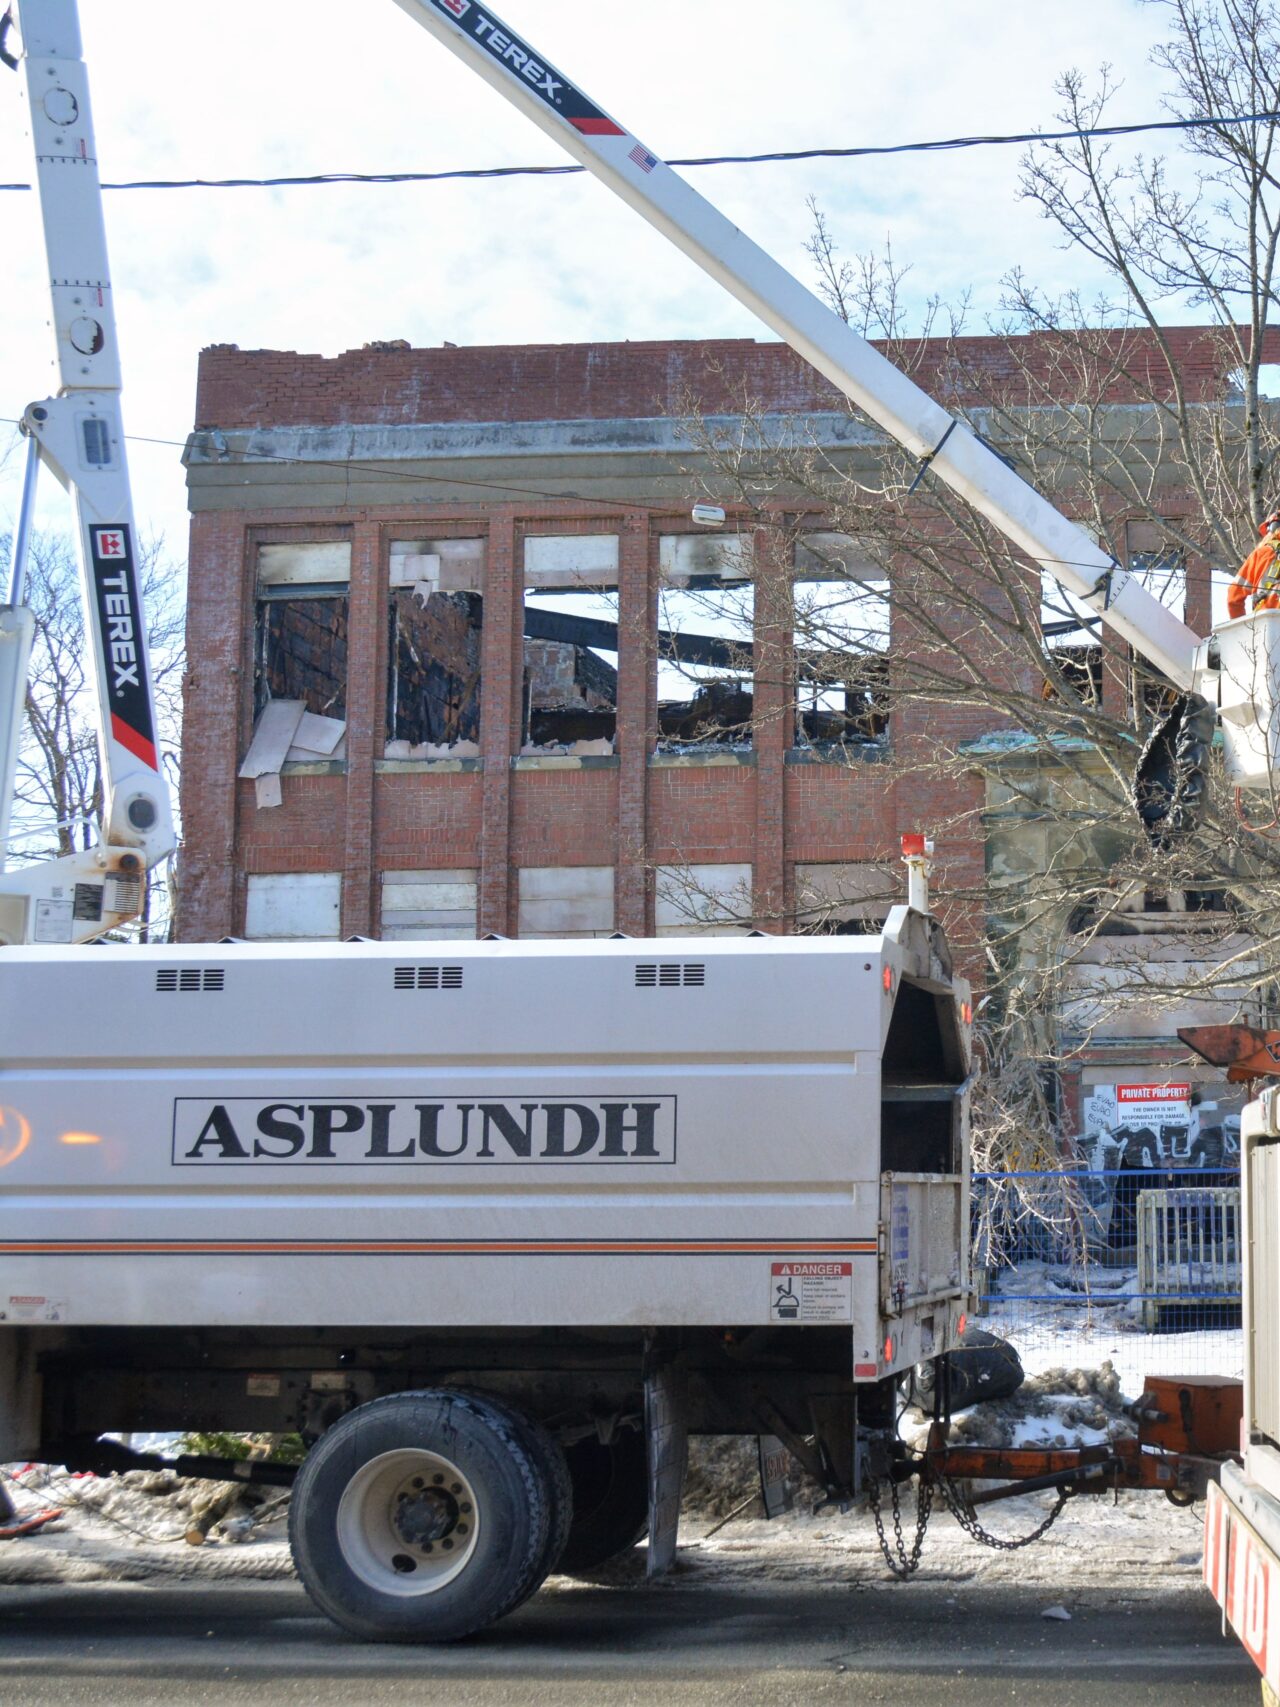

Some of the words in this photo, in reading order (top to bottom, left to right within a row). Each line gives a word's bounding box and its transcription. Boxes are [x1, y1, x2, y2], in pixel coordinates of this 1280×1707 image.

[474, 14, 563, 100] TEREX
[103, 570, 139, 689] TEREX
[1121, 1088, 1150, 1098] PRIVATE
[1152, 1087, 1188, 1098] PROPERTY
[185, 1103, 661, 1159] ASPLUNDH
[793, 1264, 842, 1275] DANGER
